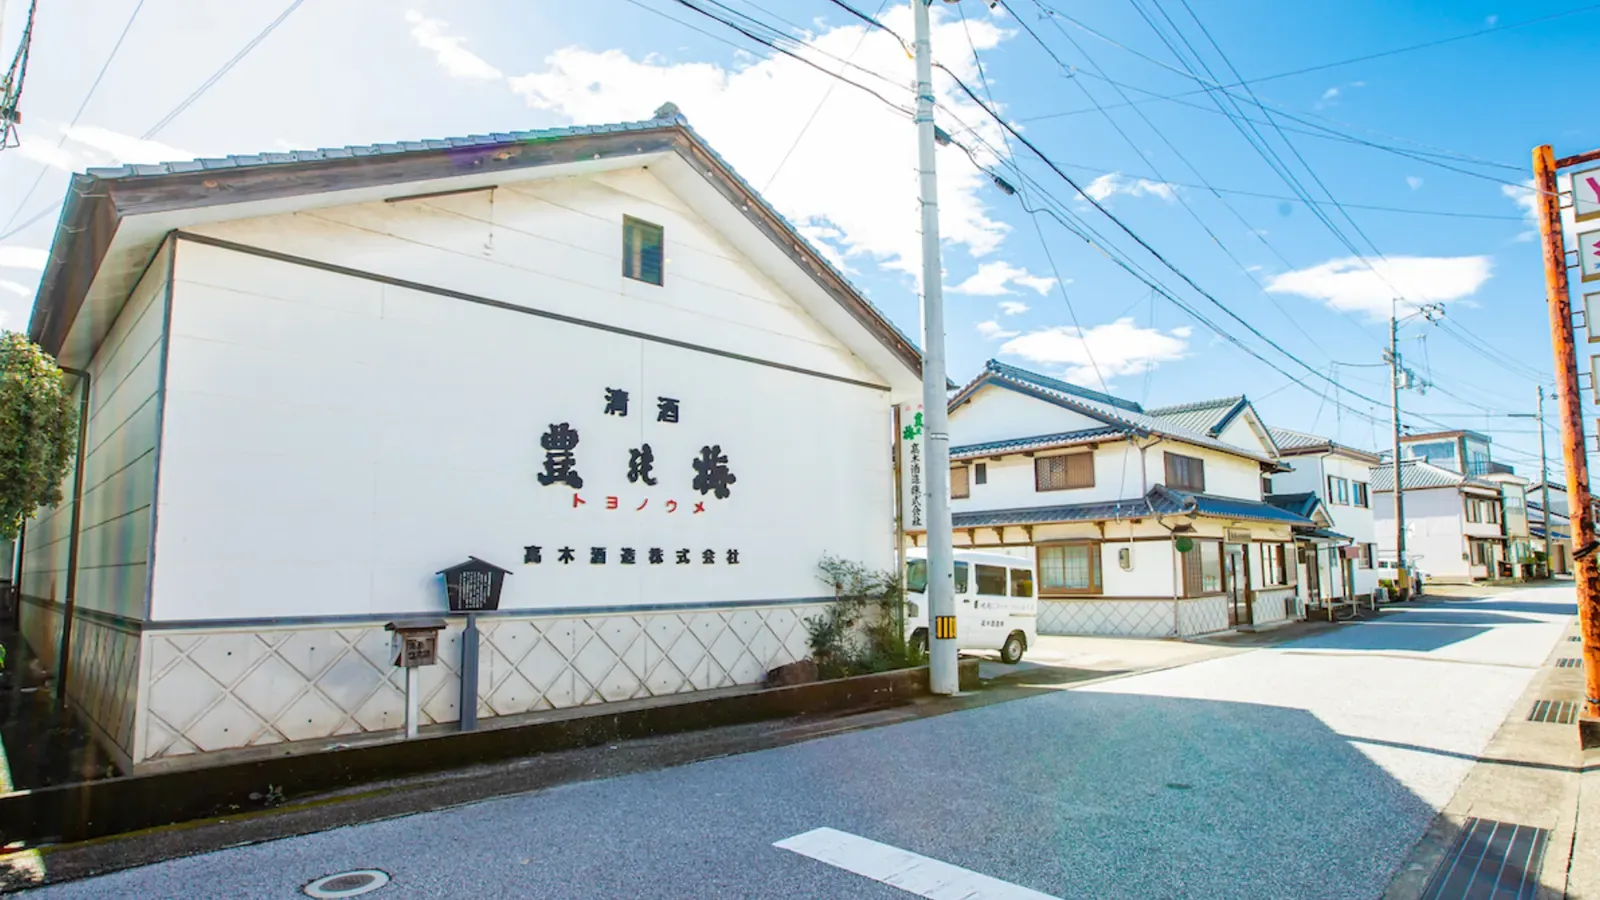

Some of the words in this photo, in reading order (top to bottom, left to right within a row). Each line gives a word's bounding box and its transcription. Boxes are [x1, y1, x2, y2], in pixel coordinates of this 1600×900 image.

[604, 387, 680, 423] 清酒
[572, 493, 705, 513] トヨノウメ
[524, 545, 740, 565] 高木酒造株式会社
